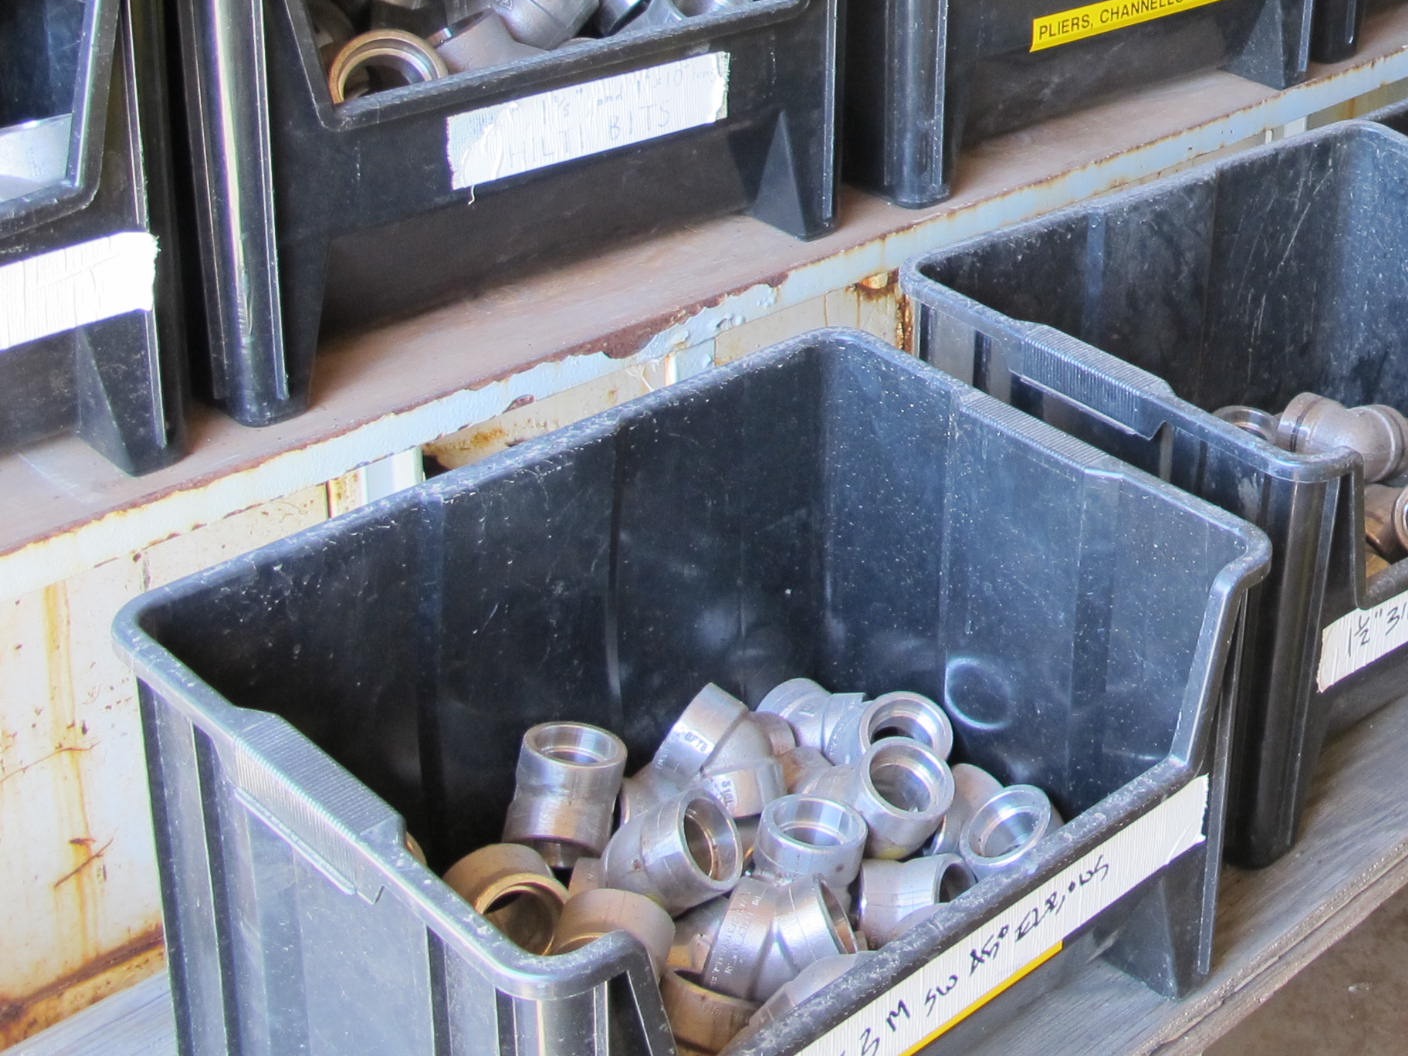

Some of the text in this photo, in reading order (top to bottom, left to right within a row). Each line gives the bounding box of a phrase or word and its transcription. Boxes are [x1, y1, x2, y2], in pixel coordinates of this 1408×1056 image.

[1039, 14, 1094, 40] PLIERS,
[508, 99, 671, 169] HILTI BITS
[924, 973, 959, 1017] SW
